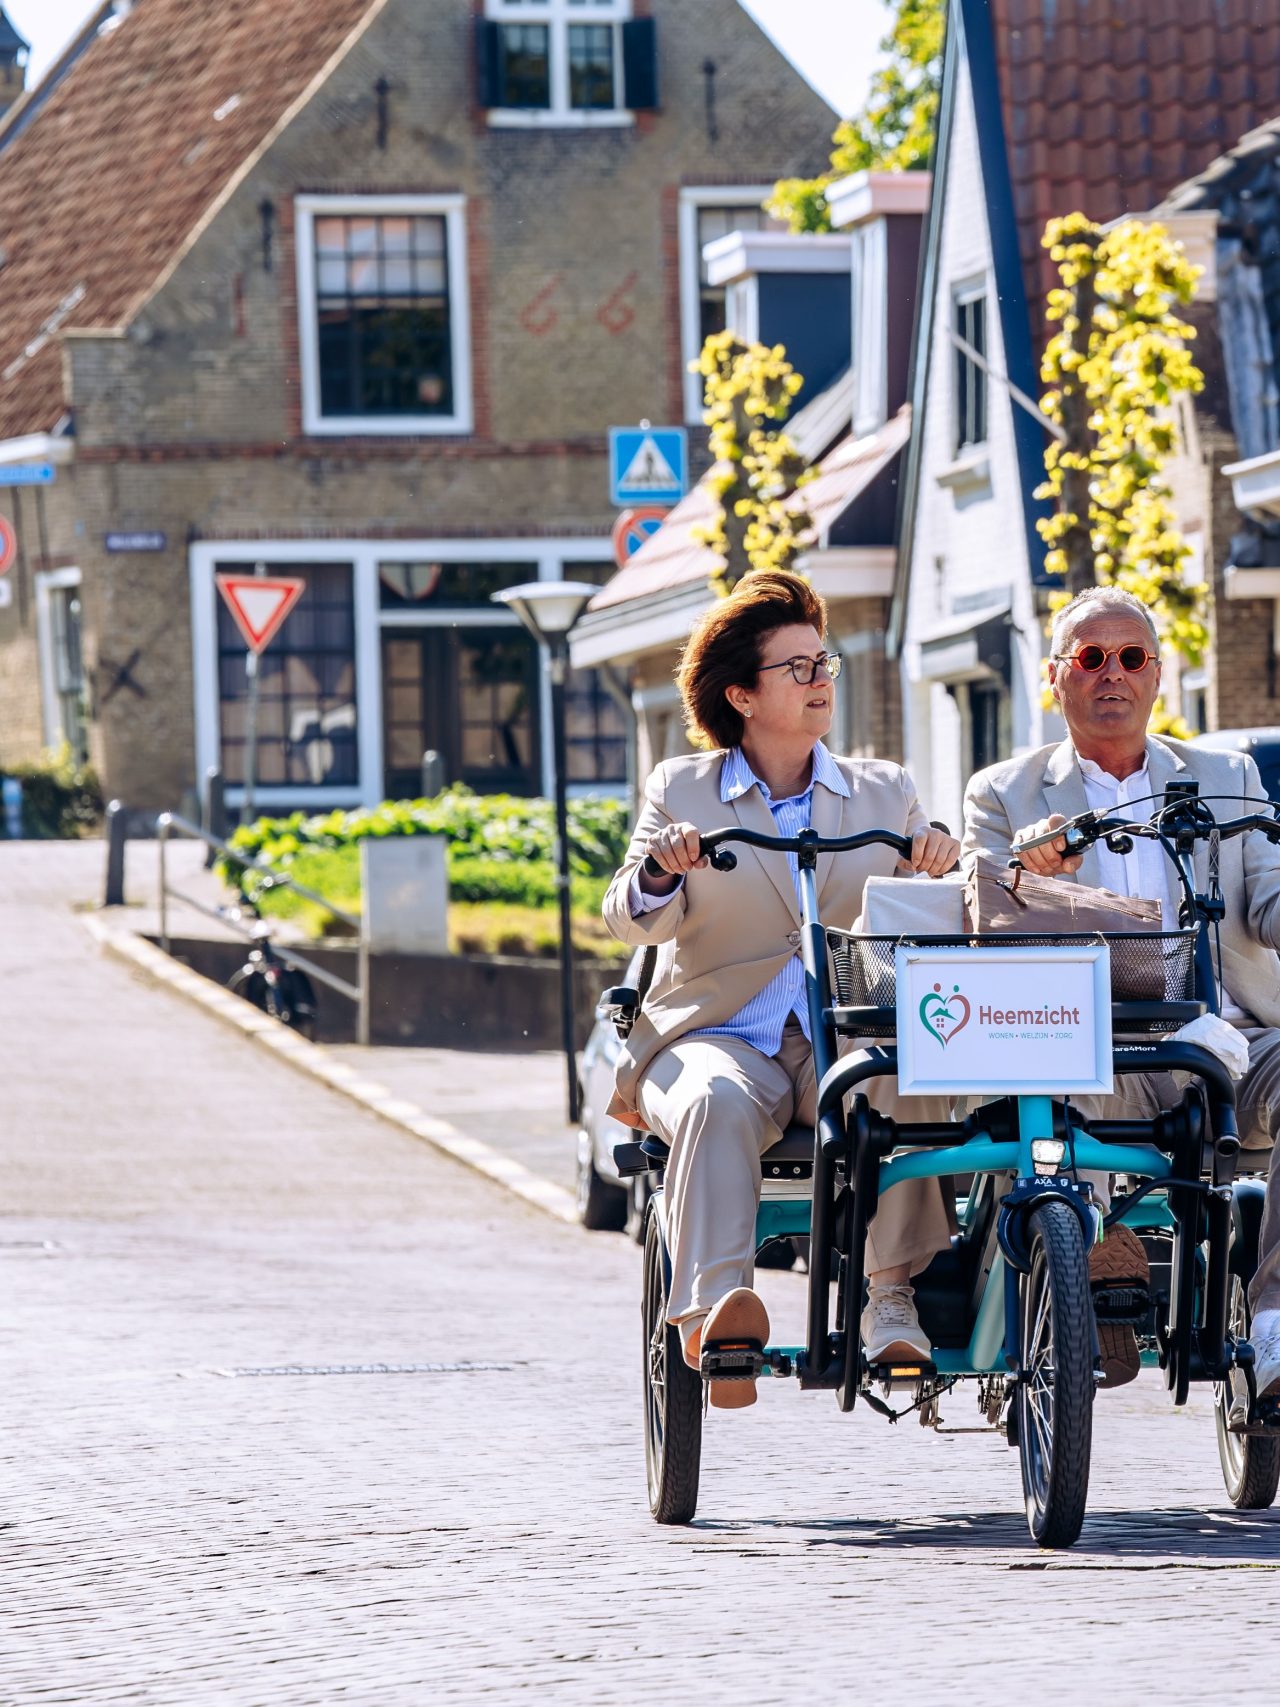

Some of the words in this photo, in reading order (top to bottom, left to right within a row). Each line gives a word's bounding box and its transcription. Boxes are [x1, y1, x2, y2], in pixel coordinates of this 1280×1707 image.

[979, 1004, 1080, 1026] Heemzicht
[988, 1032, 1015, 1040] WONEN
[1020, 1032, 1049, 1040] WELZIJN
[1054, 1032, 1073, 1040] ZORG
